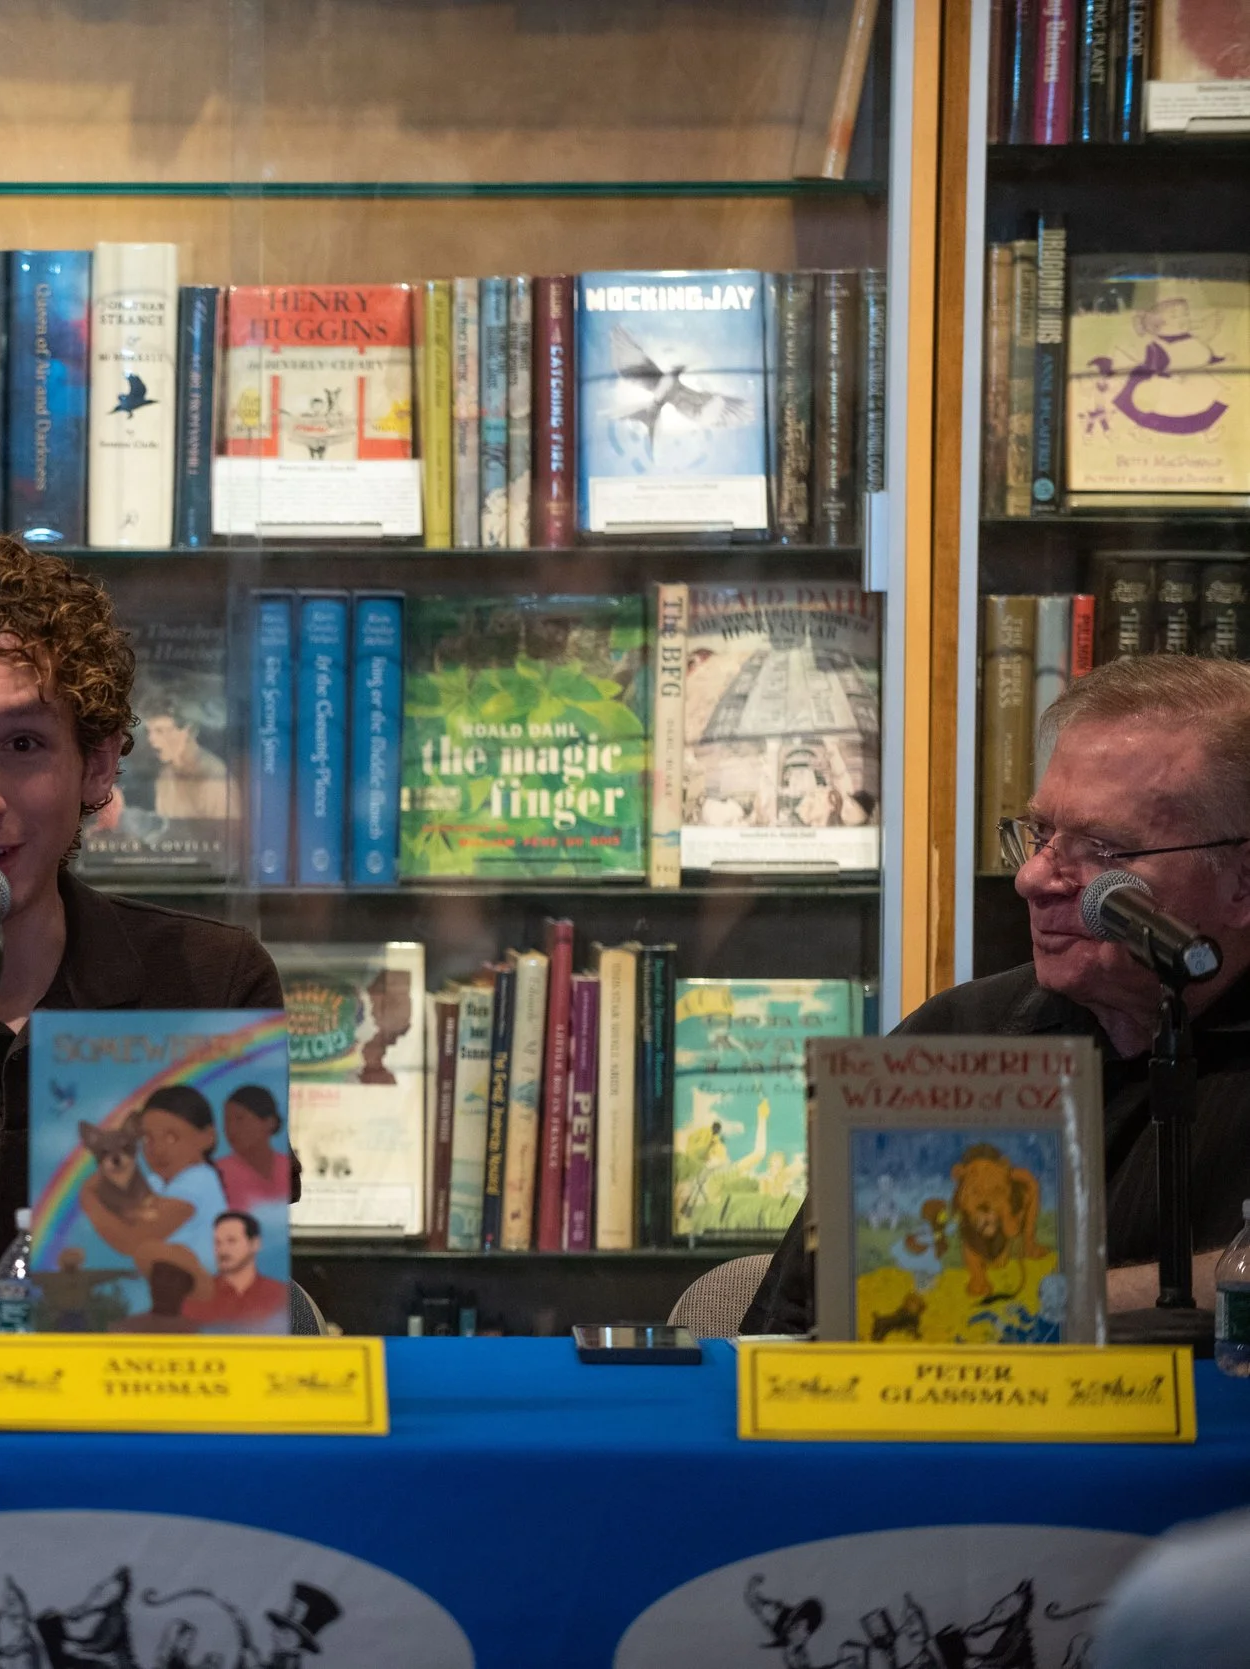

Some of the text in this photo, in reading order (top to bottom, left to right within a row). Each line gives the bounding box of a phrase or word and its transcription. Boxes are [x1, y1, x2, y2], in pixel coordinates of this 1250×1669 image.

[1132, 12, 1144, 57] DOOR
[1091, 33, 1107, 85] PLANET
[269, 290, 373, 313] HENRY
[586, 285, 755, 312] MOCKINGJAY
[99, 315, 165, 326] STRANGE
[251, 318, 389, 342] HUGGINS
[264, 361, 325, 372] BEVERLY
[550, 345, 564, 472] CATCHING FIRE
[692, 588, 784, 617] ROALD
[721, 623, 837, 641] HENRY SUGAR
[661, 596, 684, 698] The BFG
[461, 722, 580, 738] ROALD DAHL
[421, 733, 623, 785] the magic
[490, 778, 625, 831] finger
[882, 1049, 1080, 1076] WONDERFUL
[841, 1077, 974, 1110] WIZARD
[1016, 1085, 1063, 1110] OZ
[572, 1091, 592, 1161] PET
[105, 1356, 227, 1375] ANGELO
[915, 1364, 1015, 1382] PETER
[102, 1379, 230, 1398] THOMAS
[878, 1386, 1049, 1408] GLASSMAN
